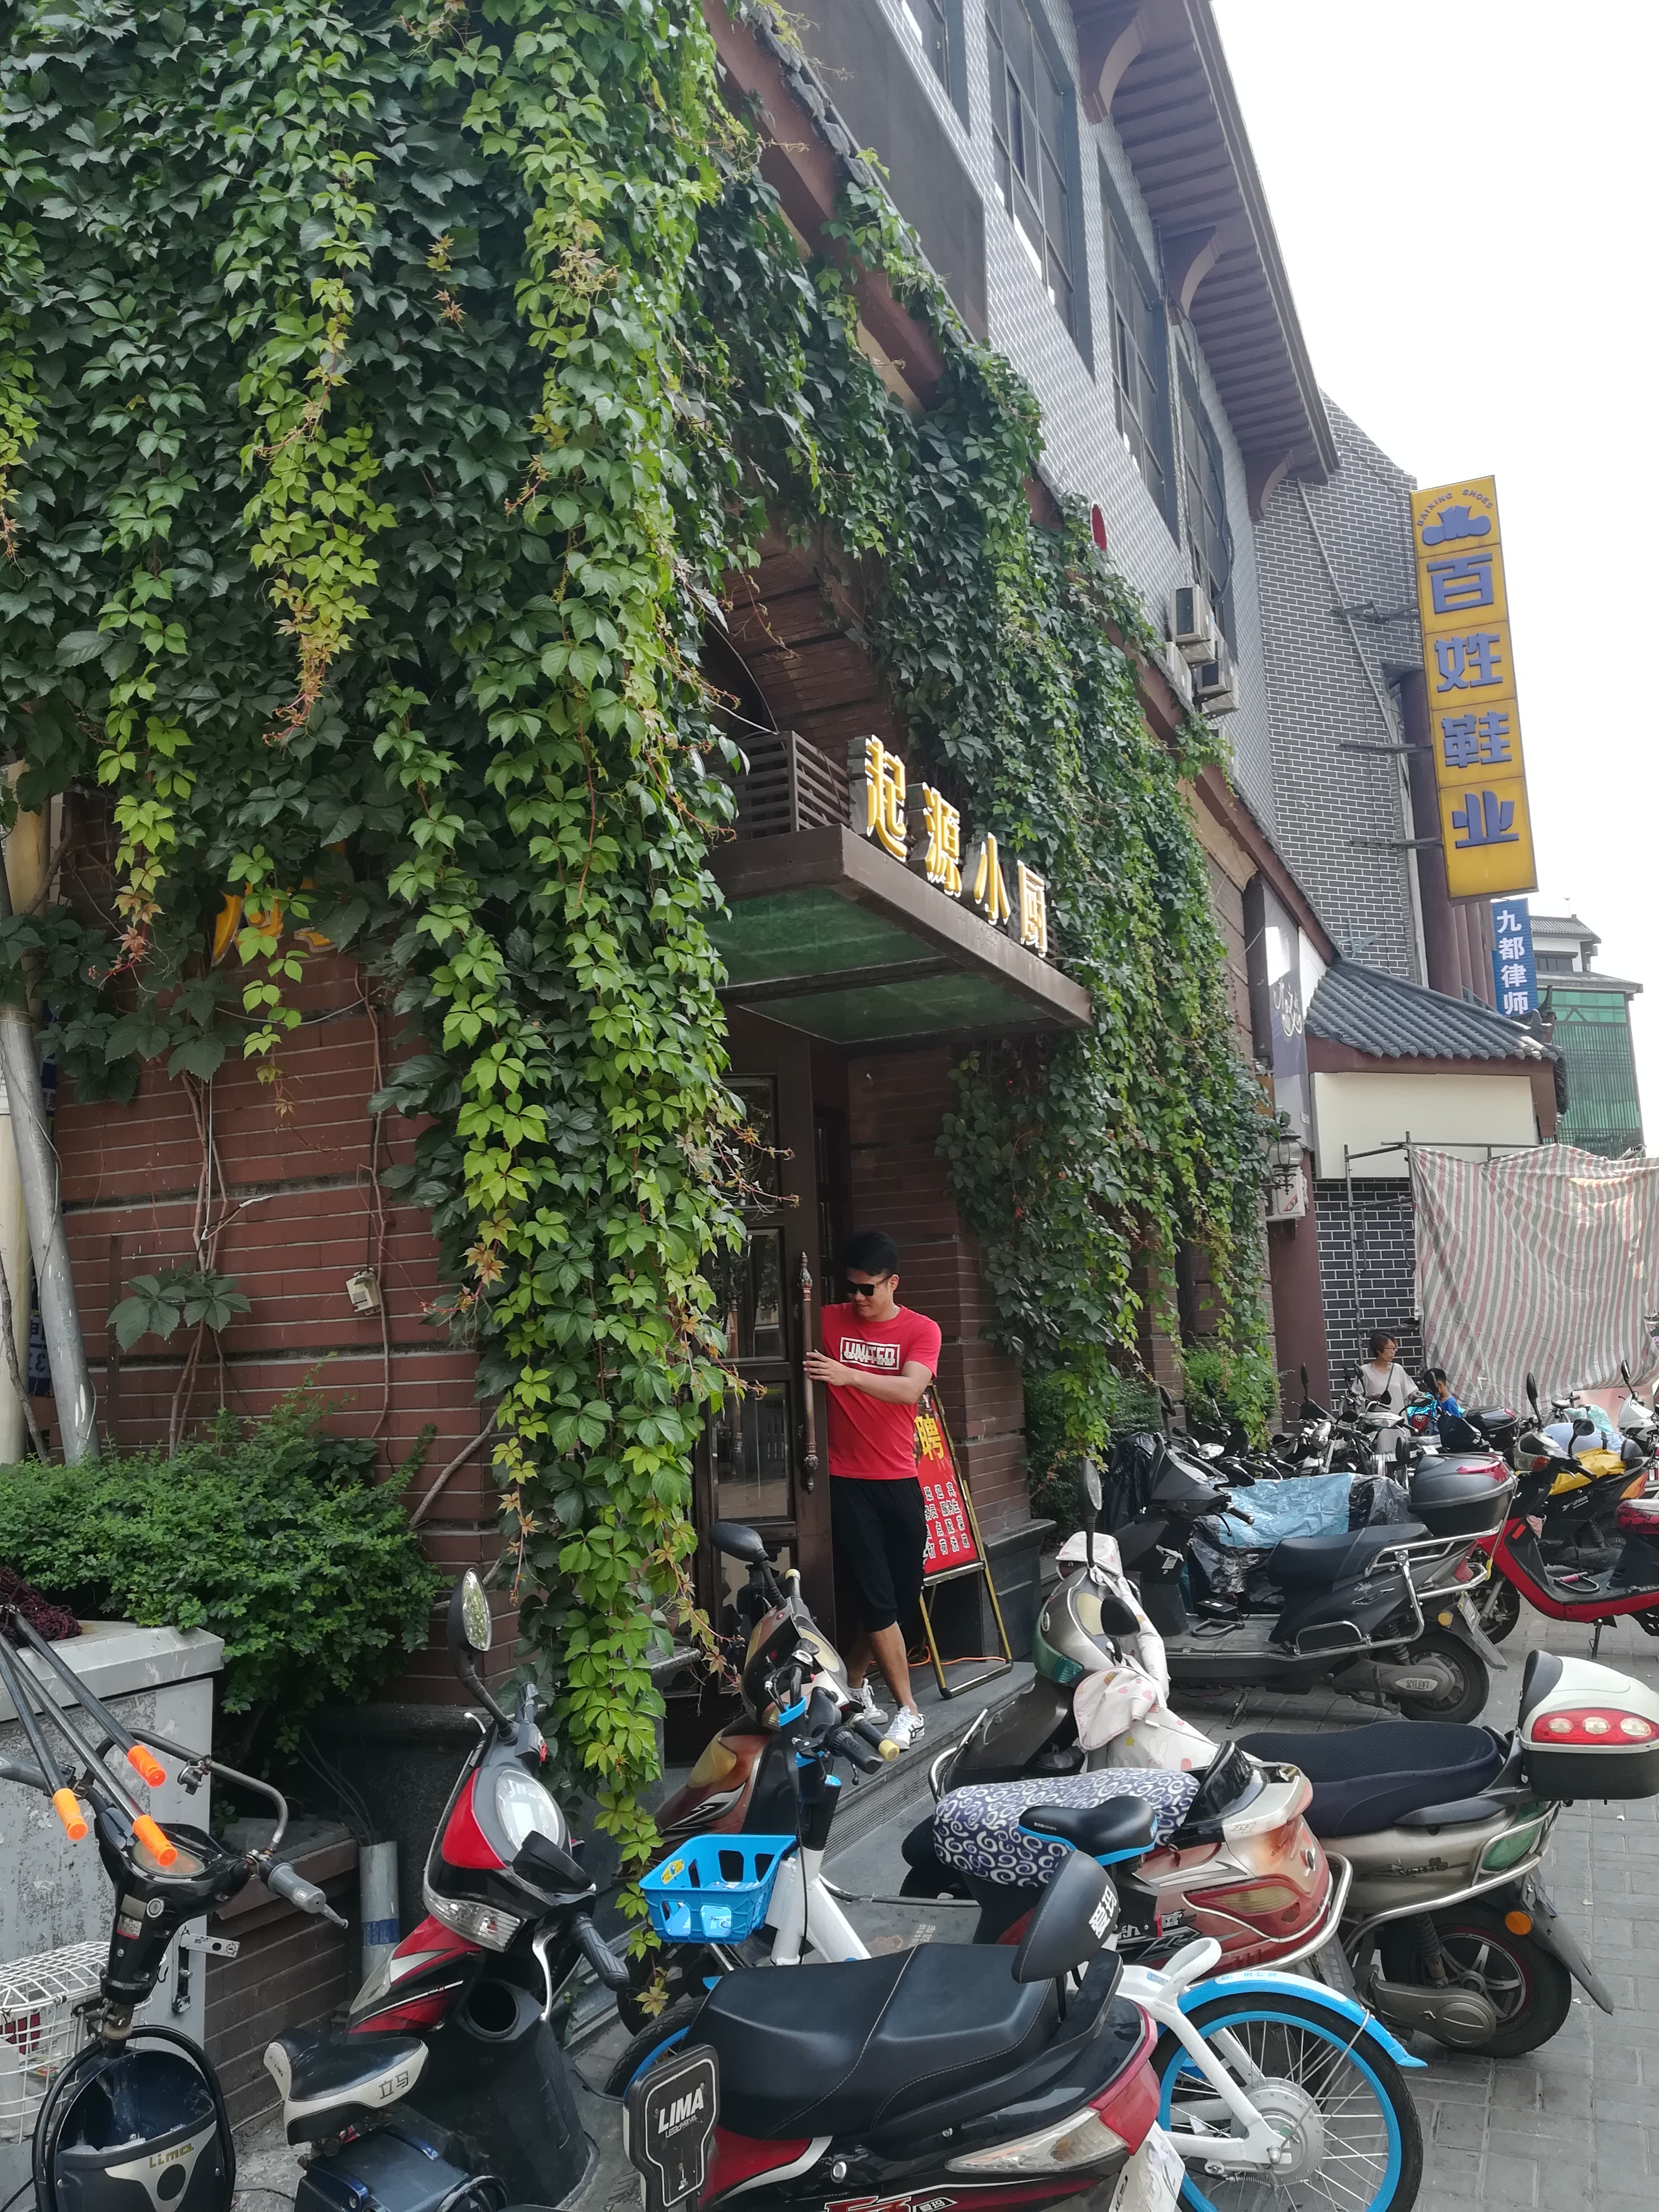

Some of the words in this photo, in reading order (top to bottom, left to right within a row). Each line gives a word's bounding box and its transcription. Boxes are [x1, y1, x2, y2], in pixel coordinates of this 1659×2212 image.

[1417, 492, 1453, 526] BAIXING
[1462, 489, 1493, 508] SHOES
[1427, 553, 1520, 849] 百姓鞋业
[863, 734, 1048, 958] 起源小厨
[1497, 910, 1529, 1015] 九都律师
[844, 1342, 895, 1366] UNITED
[913, 1413, 944, 1461] 聘
[658, 2088, 704, 2134] LIMA
